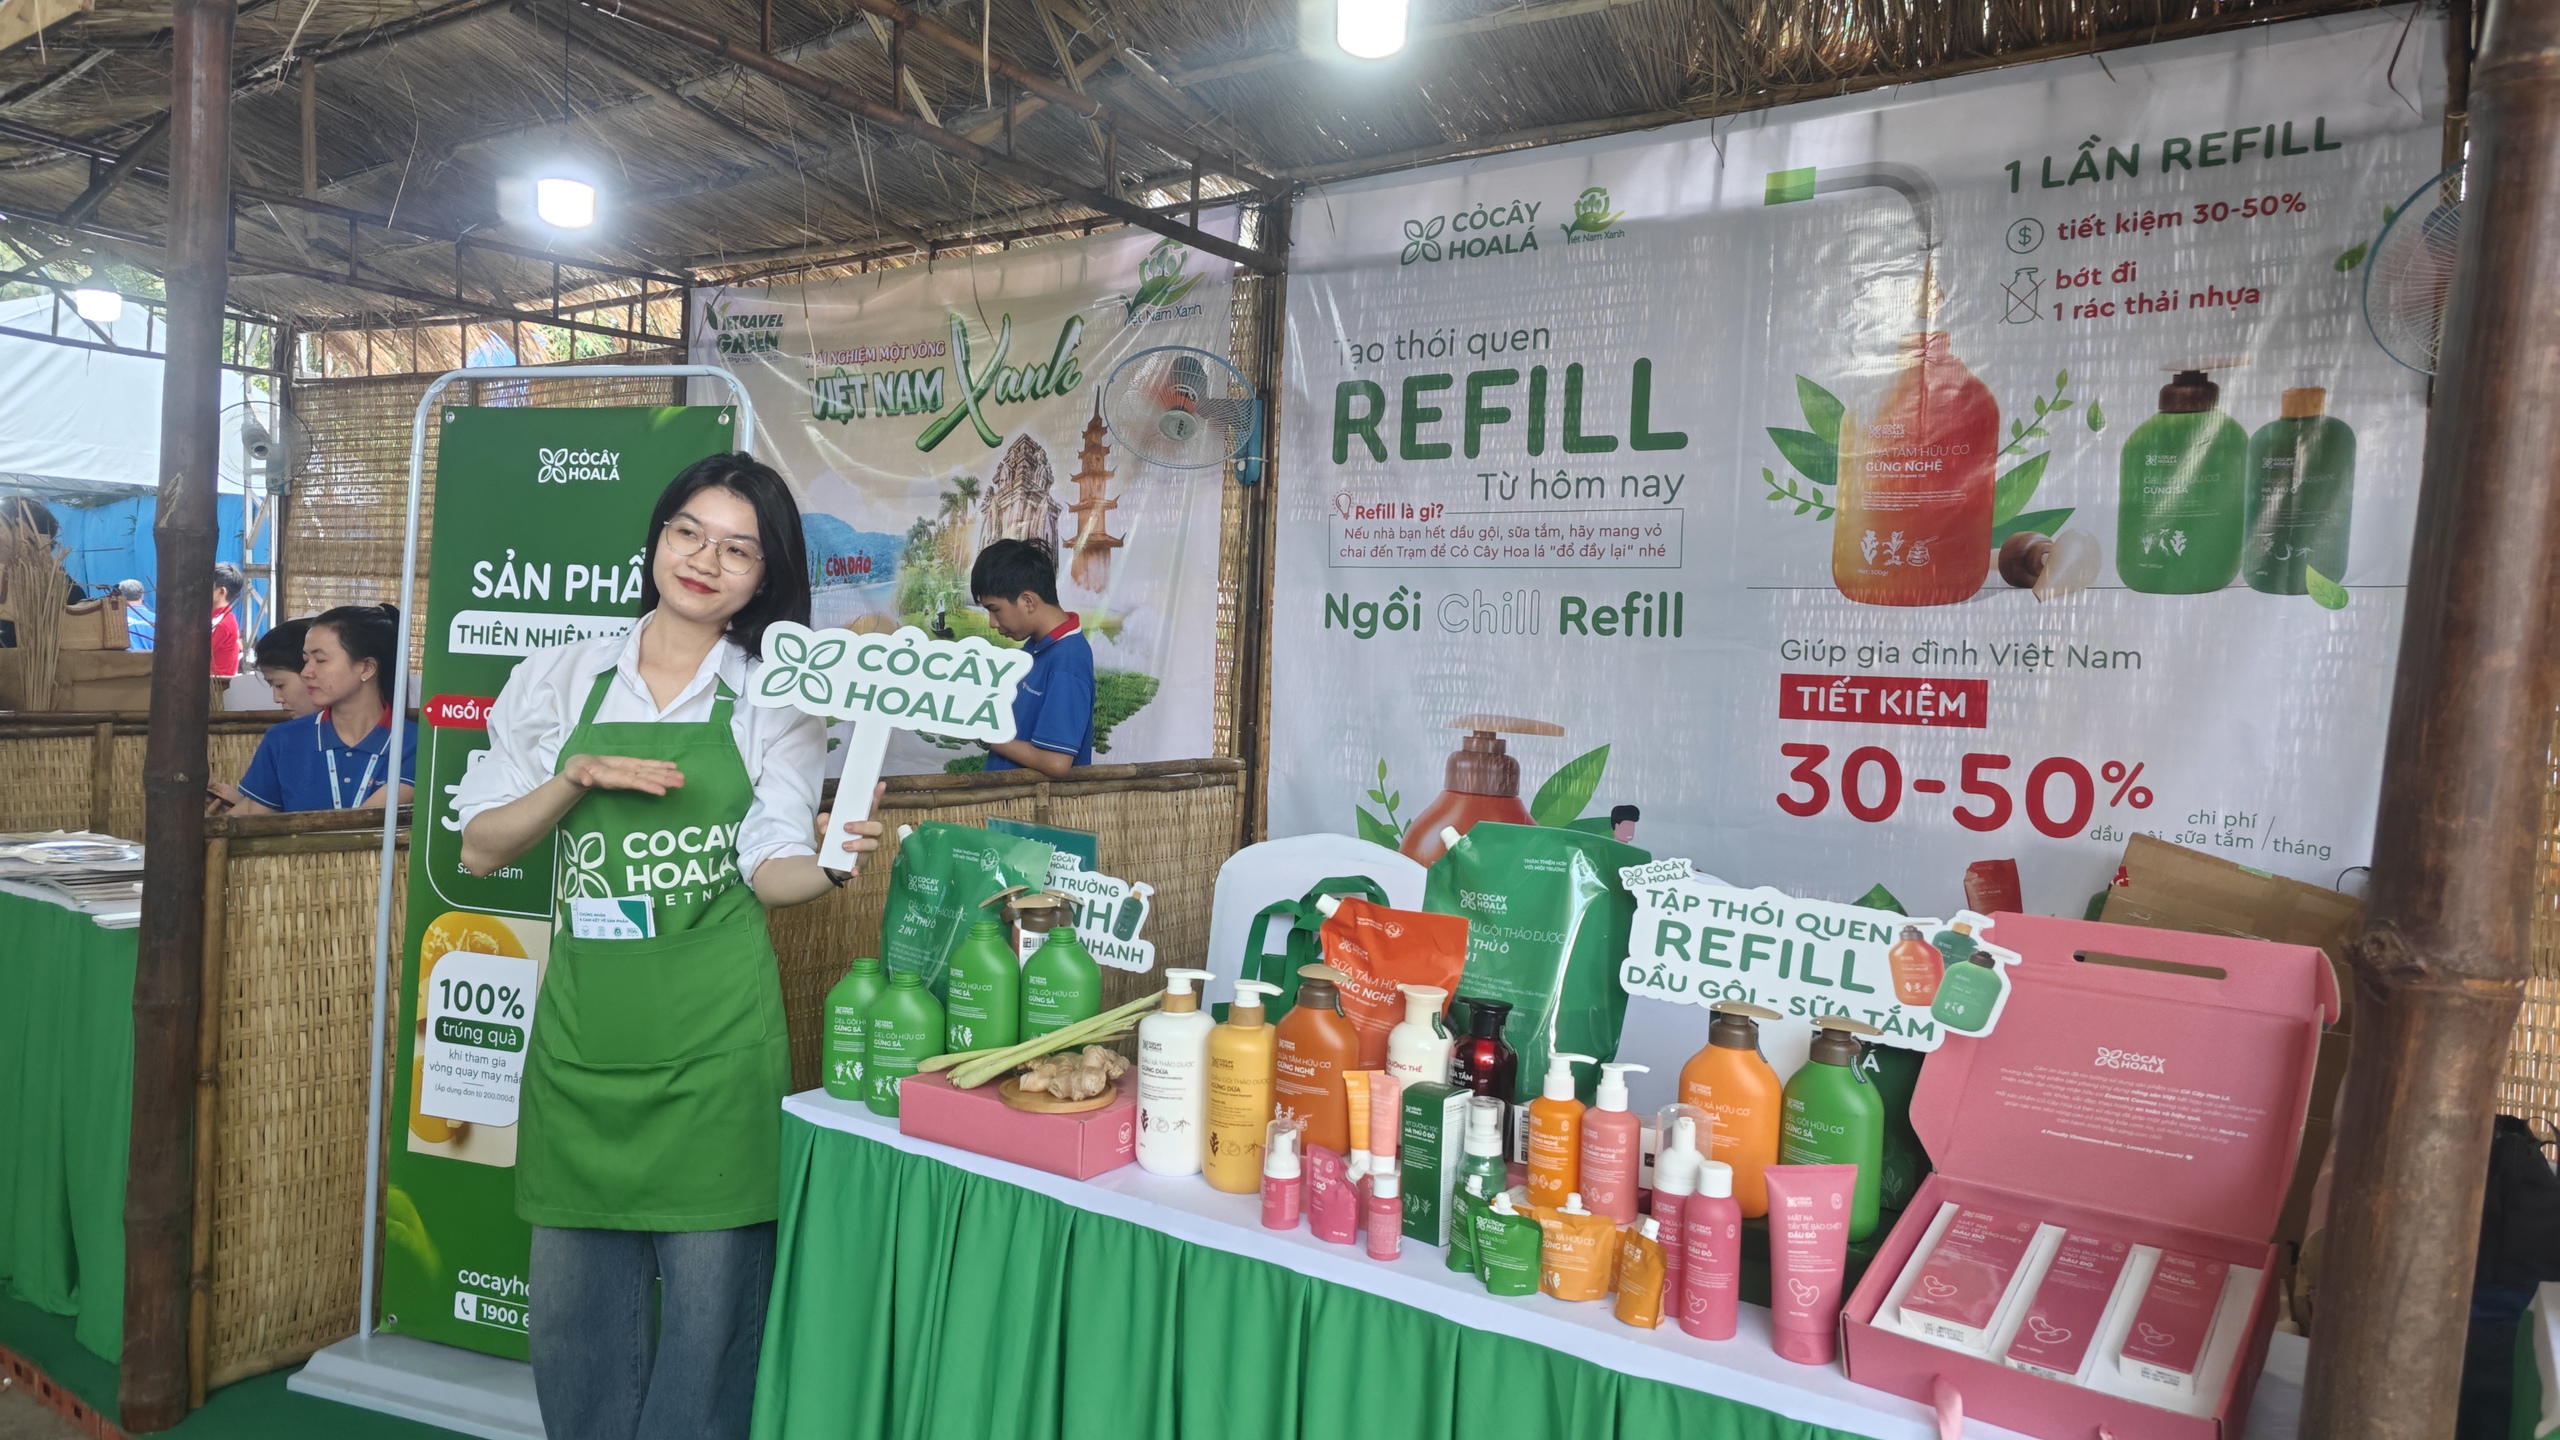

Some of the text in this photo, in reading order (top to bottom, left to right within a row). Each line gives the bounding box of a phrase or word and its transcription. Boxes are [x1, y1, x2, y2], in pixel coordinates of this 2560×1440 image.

[2004, 116, 2342, 194] 1 LẦN REFILL
[1452, 199, 1542, 232] CỎCÂY
[2057, 191, 2307, 241] tiết kiệm 30-50%
[1448, 225, 1539, 260] HOALÁ
[1582, 233, 1603, 242] Nam
[1603, 229, 1625, 240] Xanh
[2055, 261, 2137, 290] bớt đi
[1146, 309, 1172, 323] Nam
[1174, 303, 1203, 318] Xanh
[2053, 285, 2261, 322] 1 rác thải nhựa
[716, 330, 782, 354] GREEN
[830, 345, 876, 366] NGHIỆM
[879, 342, 908, 364] MỘT
[910, 340, 946, 361] VÒNG
[1333, 327, 1550, 371] Tạo thói quen
[807, 312, 1085, 452] VIỆT NAM Xanh
[1332, 357, 1689, 465] REFILL
[569, 449, 620, 466] CỎCÂY
[1920, 444, 1949, 457] HỮU
[1952, 444, 1970, 456] CƠ
[569, 465, 620, 481] HOALÁ
[1866, 458, 1943, 473] GỪNG NGHỆ
[1477, 468, 1685, 504] Từ hôm nay
[1355, 503, 1444, 522] Refill là gì?
[1344, 523, 1662, 542] Nếu nhà bạn hết dầu gội, sữa tắm, hãy mang vỏ
[1340, 542, 1666, 560] chai đến Trạm để Cỏ Cây Hoa lá "đổ đầy lại" nhé
[471, 547, 646, 604] SẢN PHẨ
[1324, 584, 1684, 640] Ngồi Chill Refill
[457, 620, 518, 646] THIÊN
[857, 638, 1016, 688] CỎCÂY
[1780, 638, 2143, 673] Giúp gia đình Việt Nam
[442, 699, 479, 720] NGỒI
[843, 681, 1000, 730] HOALÁ
[1796, 677, 1968, 725] TIẾT KIỆM
[1776, 742, 2154, 839] 30-50%
[2187, 809, 2258, 829] chi phí
[622, 821, 741, 859] COCAY
[2090, 825, 2124, 842] dầu
[2174, 830, 2207, 844] sữa
[2215, 829, 2254, 849] tắm
[2272, 837, 2332, 861] tháng
[625, 852, 738, 892] HOALA
[1645, 861, 1686, 874] CỎCÂY
[1648, 870, 1690, 884] HOALÁ
[918, 877, 939, 885] COCAY
[918, 883, 939, 892] HOALA
[1060, 877, 1119, 898] TRƯỜNG
[1477, 892, 1508, 903] COCAY
[1477, 901, 1508, 911] HOALA
[1646, 887, 1893, 946] TẬP THÓI QUEN
[1468, 919, 1566, 945] ẦU GỘI THẢO DƯỢC
[1473, 938, 1510, 954] THỦ Ô
[1654, 919, 1875, 995] REFILL
[1331, 958, 1378, 986] SỮA TẮM
[440, 978, 525, 1020] 100%
[1362, 988, 1396, 1006] NGHỆ
[1626, 962, 1688, 993] DẦU
[1863, 1004, 1935, 1042] TẮM
[442, 1021, 517, 1047] trúng quà
[449, 1048, 506, 1069] khi tham gia
[429, 1061, 453, 1076] vòng
[455, 1066, 479, 1080] quay
[481, 1070, 501, 1083] may
[446, 1086, 462, 1096] dụng
[1715, 1104, 1735, 1115] HỮU
[1736, 1107, 1750, 1117] CƠ
[1810, 1120, 1828, 1132] HỮU
[1830, 1125, 1845, 1136] CƠ
[481, 1303, 518, 1325] 1900
